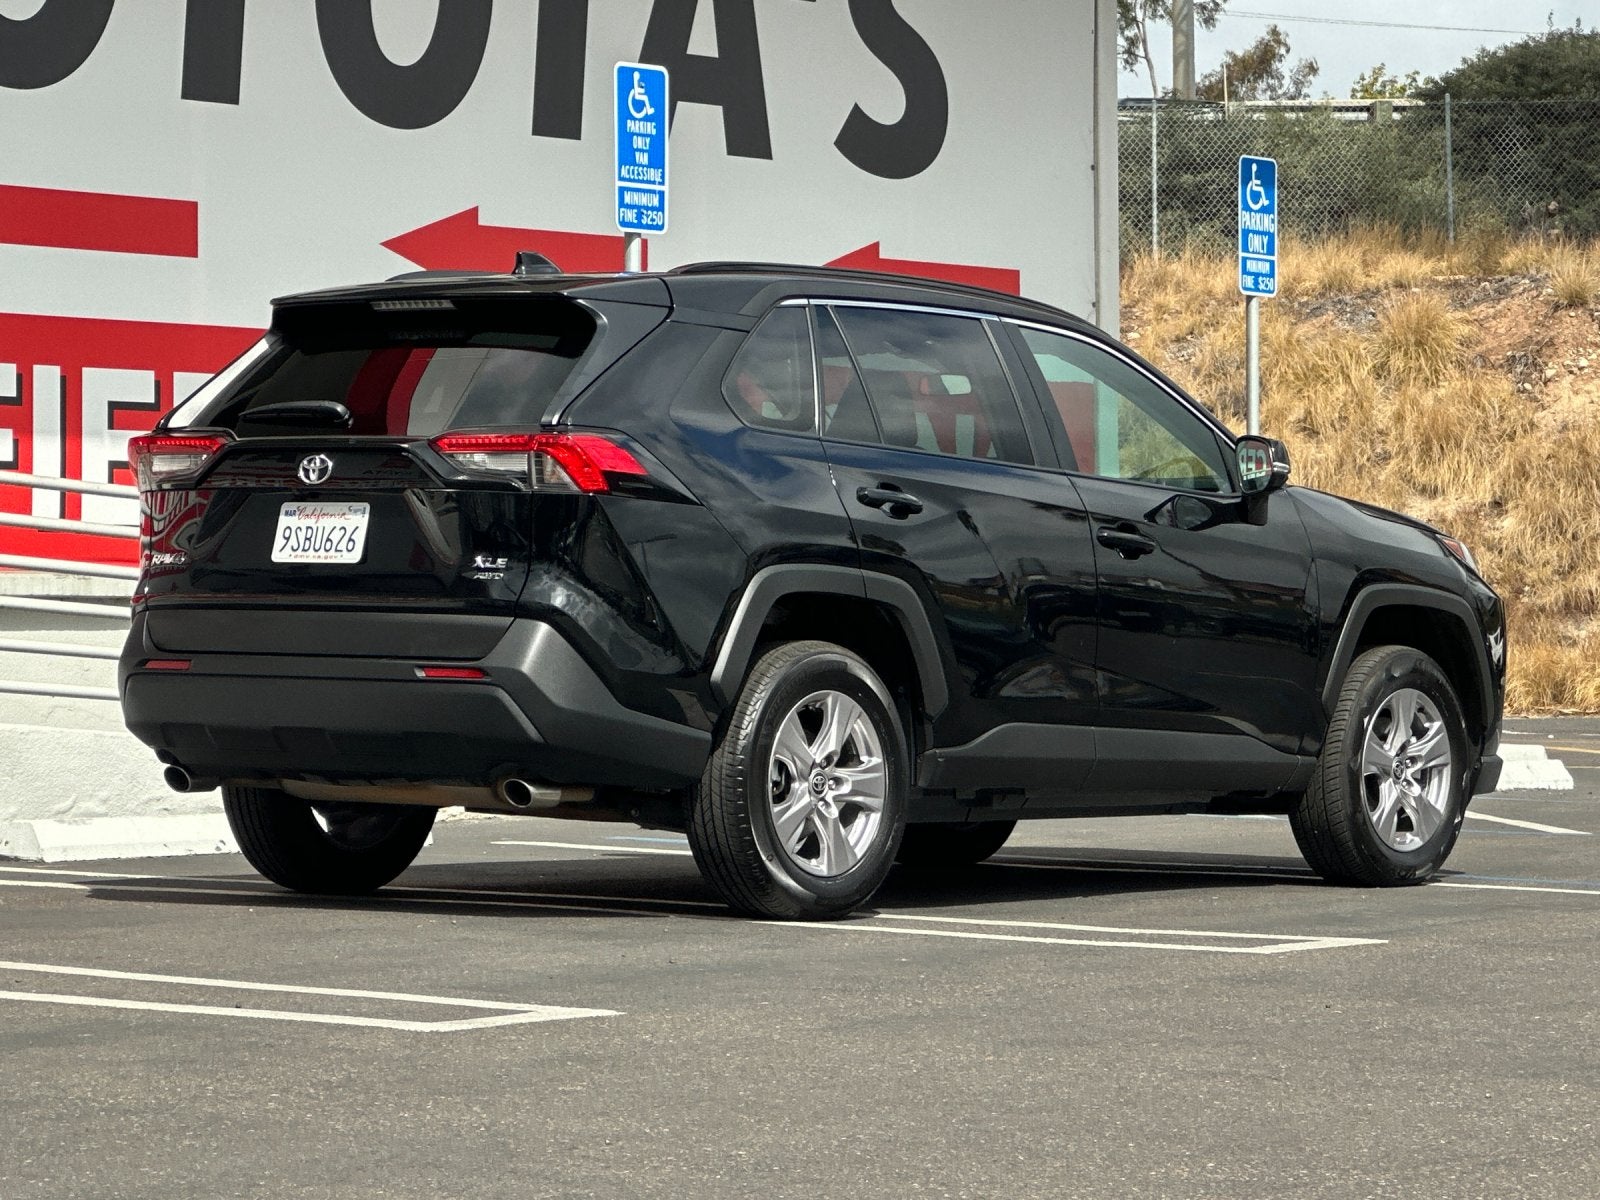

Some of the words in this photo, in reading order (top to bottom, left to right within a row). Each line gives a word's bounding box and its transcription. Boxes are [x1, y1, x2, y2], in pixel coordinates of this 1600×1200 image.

[627, 119, 656, 135] PARKING
[633, 136, 650, 150] ONLY
[635, 151, 648, 166] VAN
[620, 165, 662, 182] ACCESSIBLE
[624, 190, 659, 208] MINIMUM
[620, 208, 638, 225] FINE
[1241, 210, 1275, 233] PARKING
[1247, 233, 1269, 254] ONLY
[1246, 259, 1270, 275] MINIMUM
[1242, 274, 1255, 289] FINE
[1258, 276, 1274, 291] $250
[284, 509, 297, 517] MAR
[296, 505, 352, 524] California
[279, 525, 360, 553] 9SBU626
